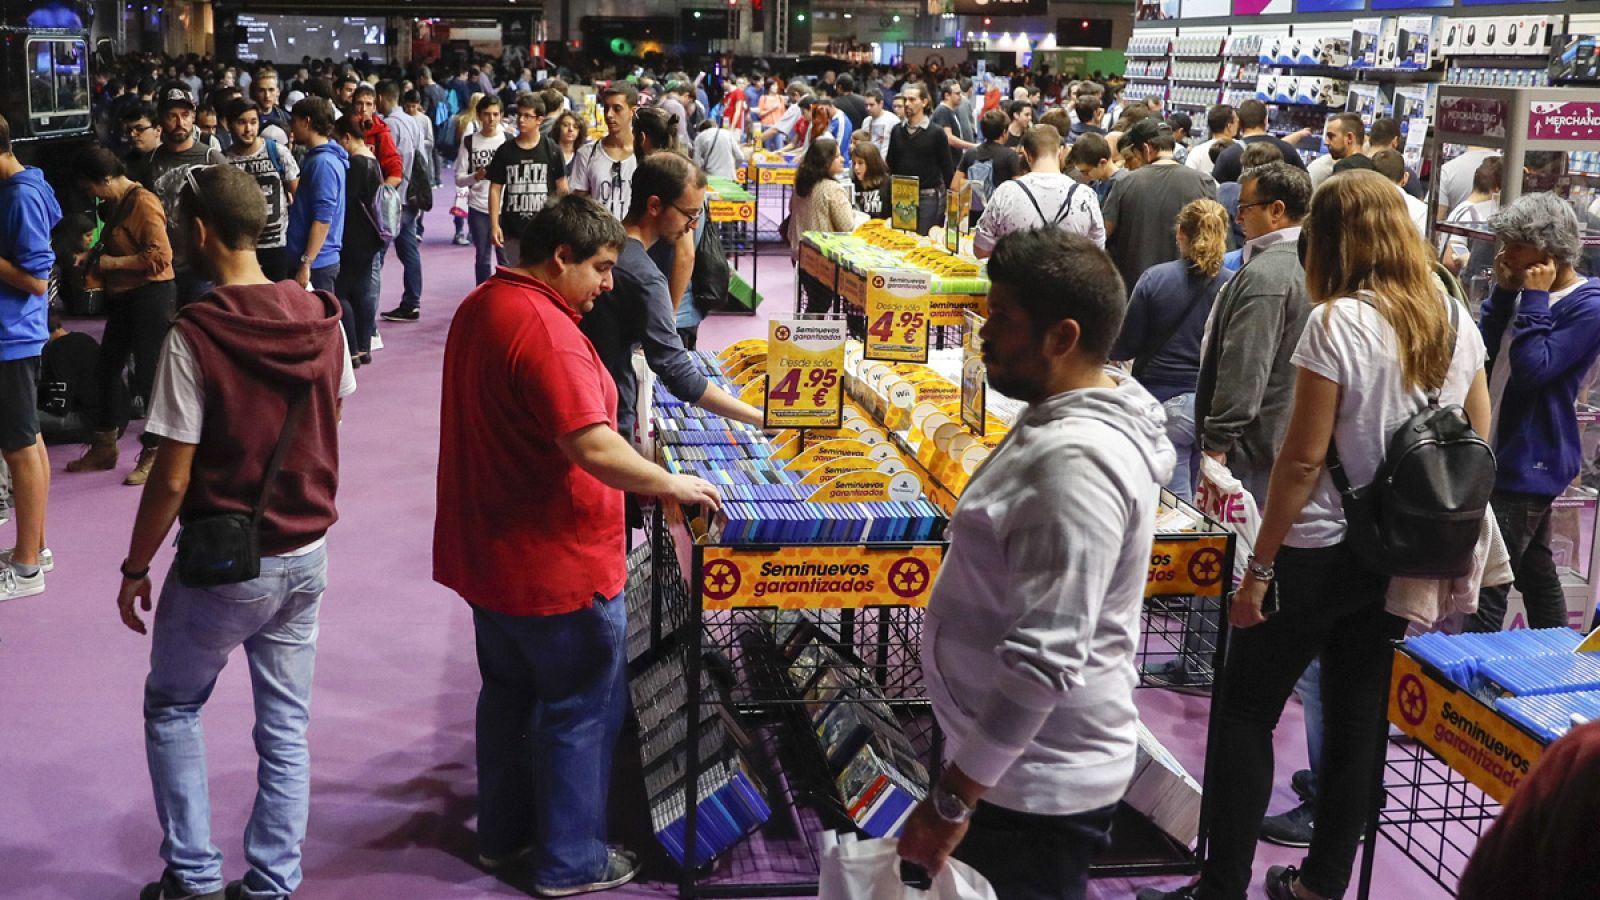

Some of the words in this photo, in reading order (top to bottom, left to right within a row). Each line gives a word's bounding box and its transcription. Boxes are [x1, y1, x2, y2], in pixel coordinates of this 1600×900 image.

[1447, 111, 1497, 123] MERCHANDISING
[505, 163, 549, 184] PLATA
[889, 276, 926, 285] Seminuevos
[876, 302, 902, 311] Desde
[904, 328, 917, 344] €
[780, 357, 810, 367] Desde
[812, 387, 829, 407] €
[818, 447, 865, 457] Seminuevos
[835, 481, 884, 489] Seminuevos
[829, 489, 884, 499] garantizados
[760, 561, 870, 577] Seminuevos
[753, 578, 875, 597] garantizados
[1440, 702, 1531, 774] Seminuevos
[1433, 723, 1521, 789] garantizad
